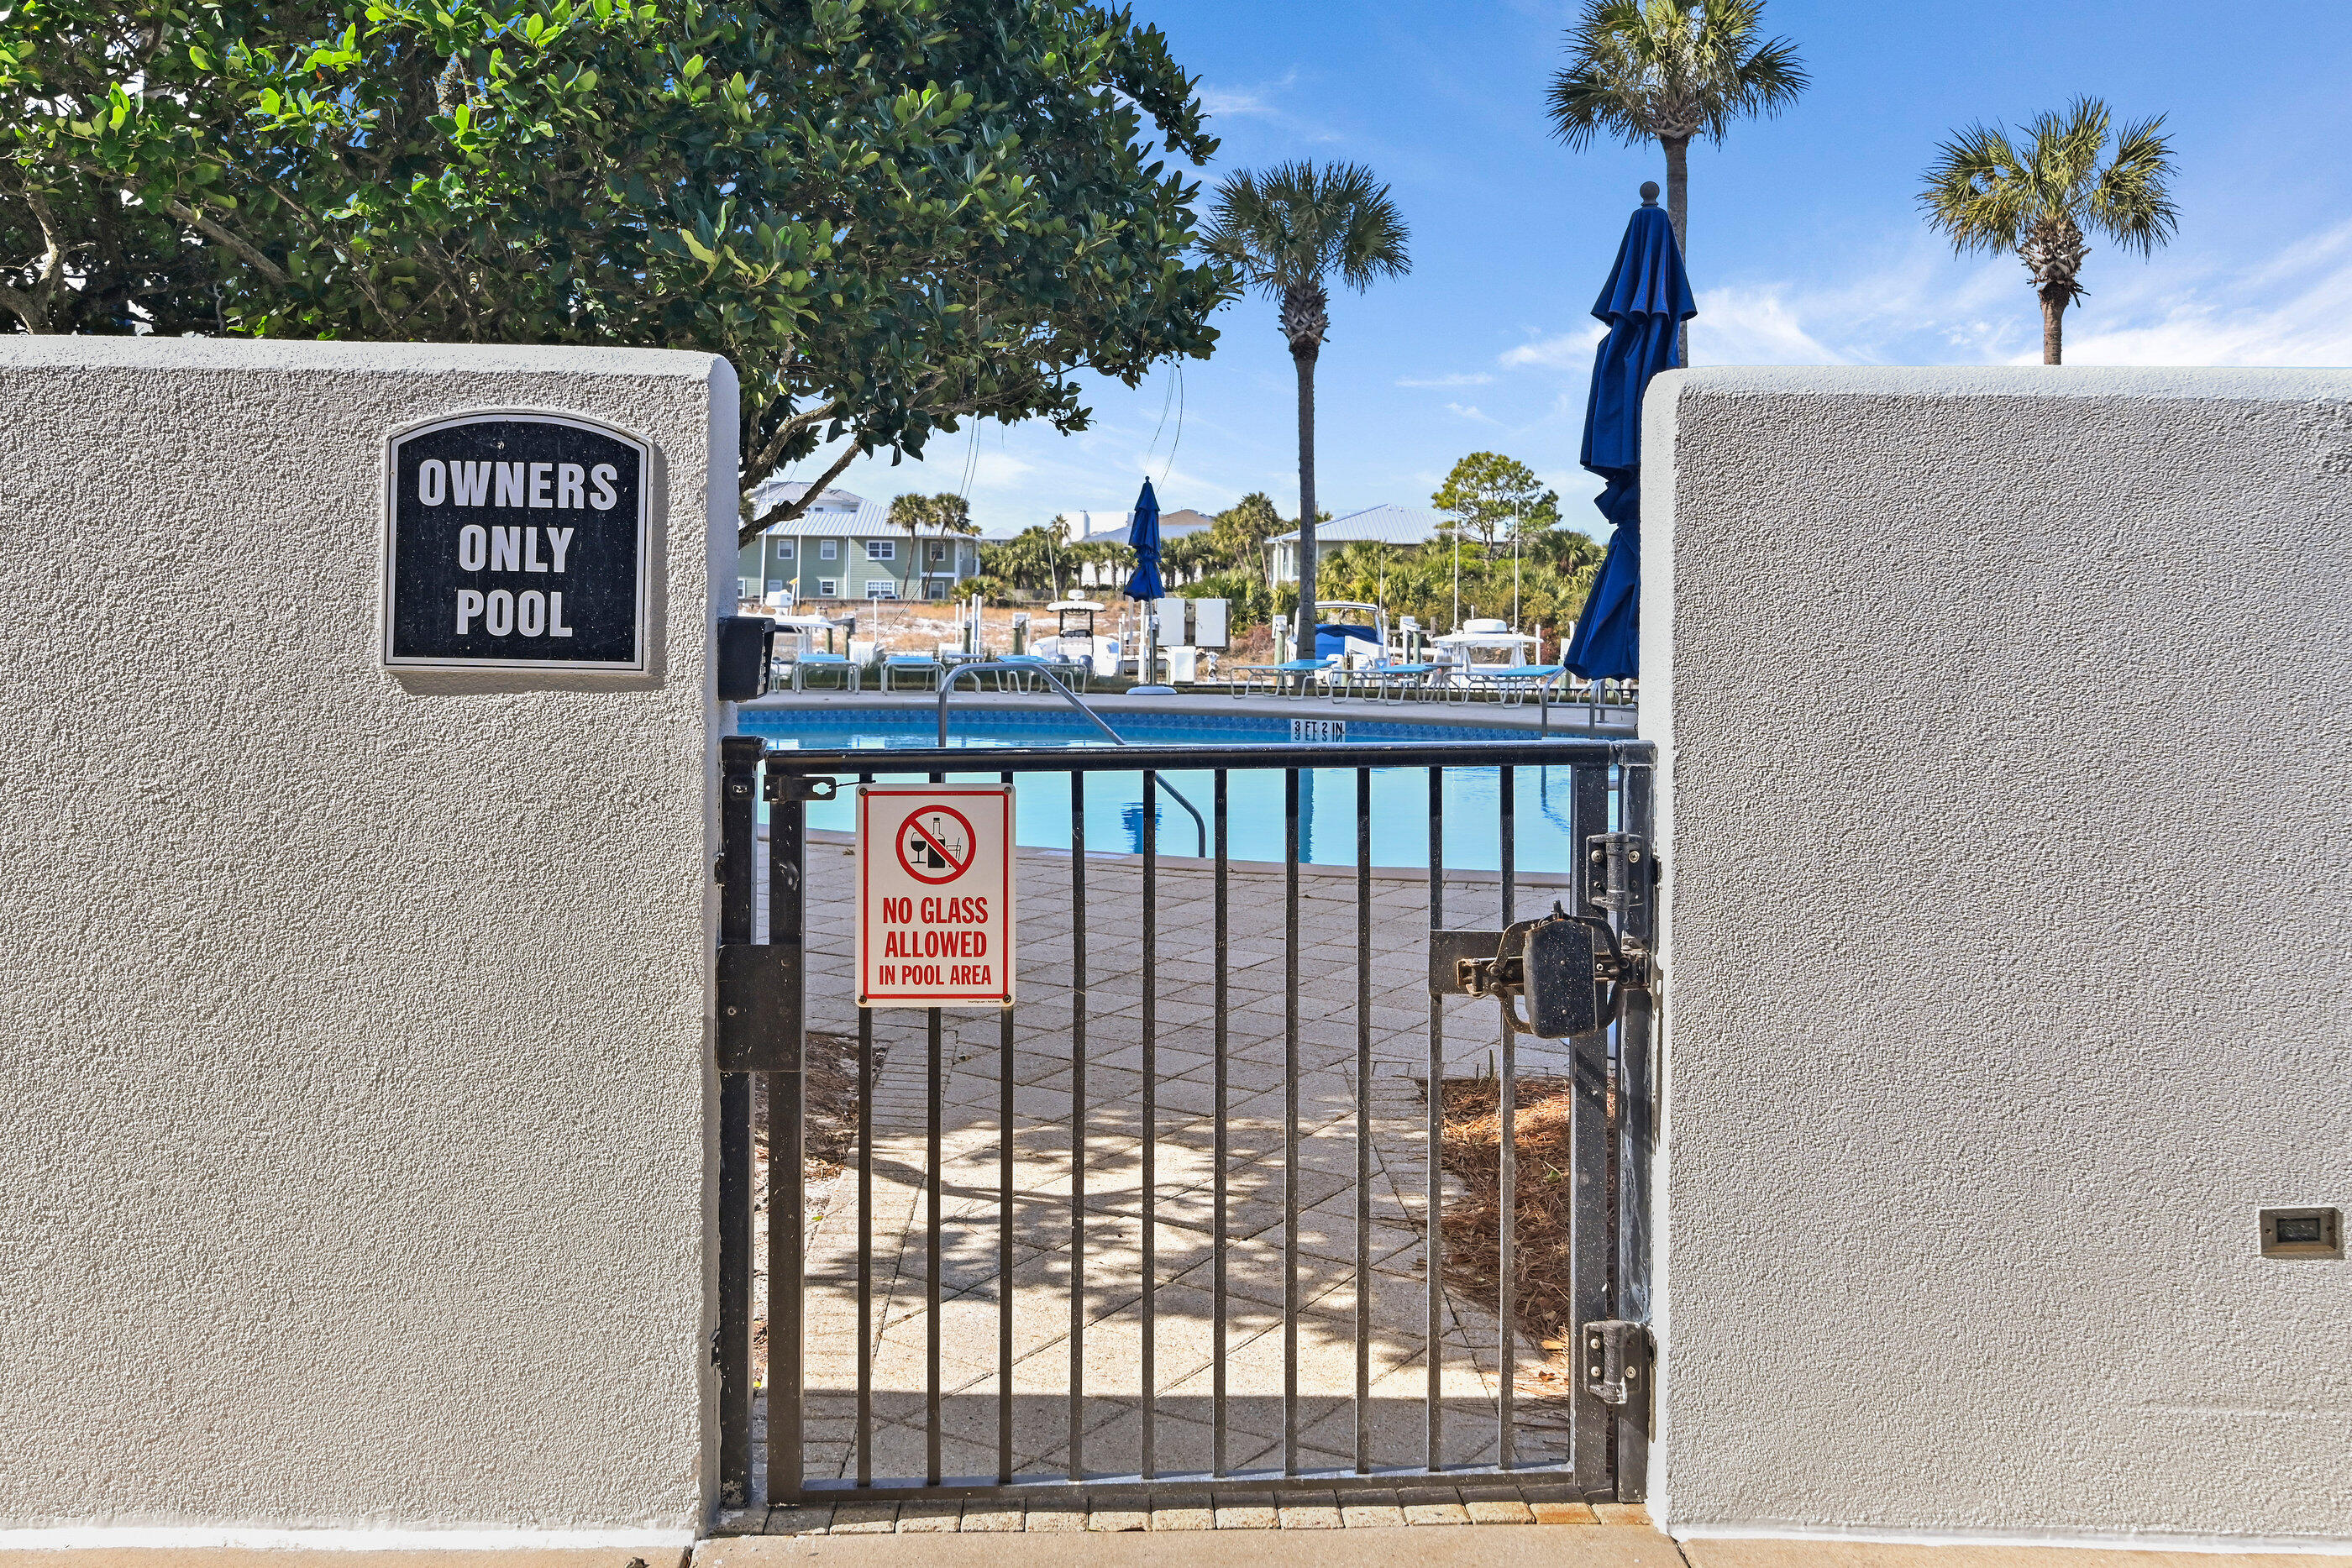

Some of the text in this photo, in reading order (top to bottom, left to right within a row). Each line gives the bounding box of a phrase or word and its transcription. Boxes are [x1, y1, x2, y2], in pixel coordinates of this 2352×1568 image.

[418, 459, 617, 511] OWNERS
[459, 524, 574, 573] ONLY
[456, 589, 573, 637] POOL
[1294, 721, 1300, 732] 3
[1321, 721, 1328, 733] 2
[1332, 722, 1345, 734] IN.
[883, 897, 989, 924] NO GLASS
[885, 931, 987, 958] ALLOWED
[879, 965, 992, 985] IN POOL AREA
